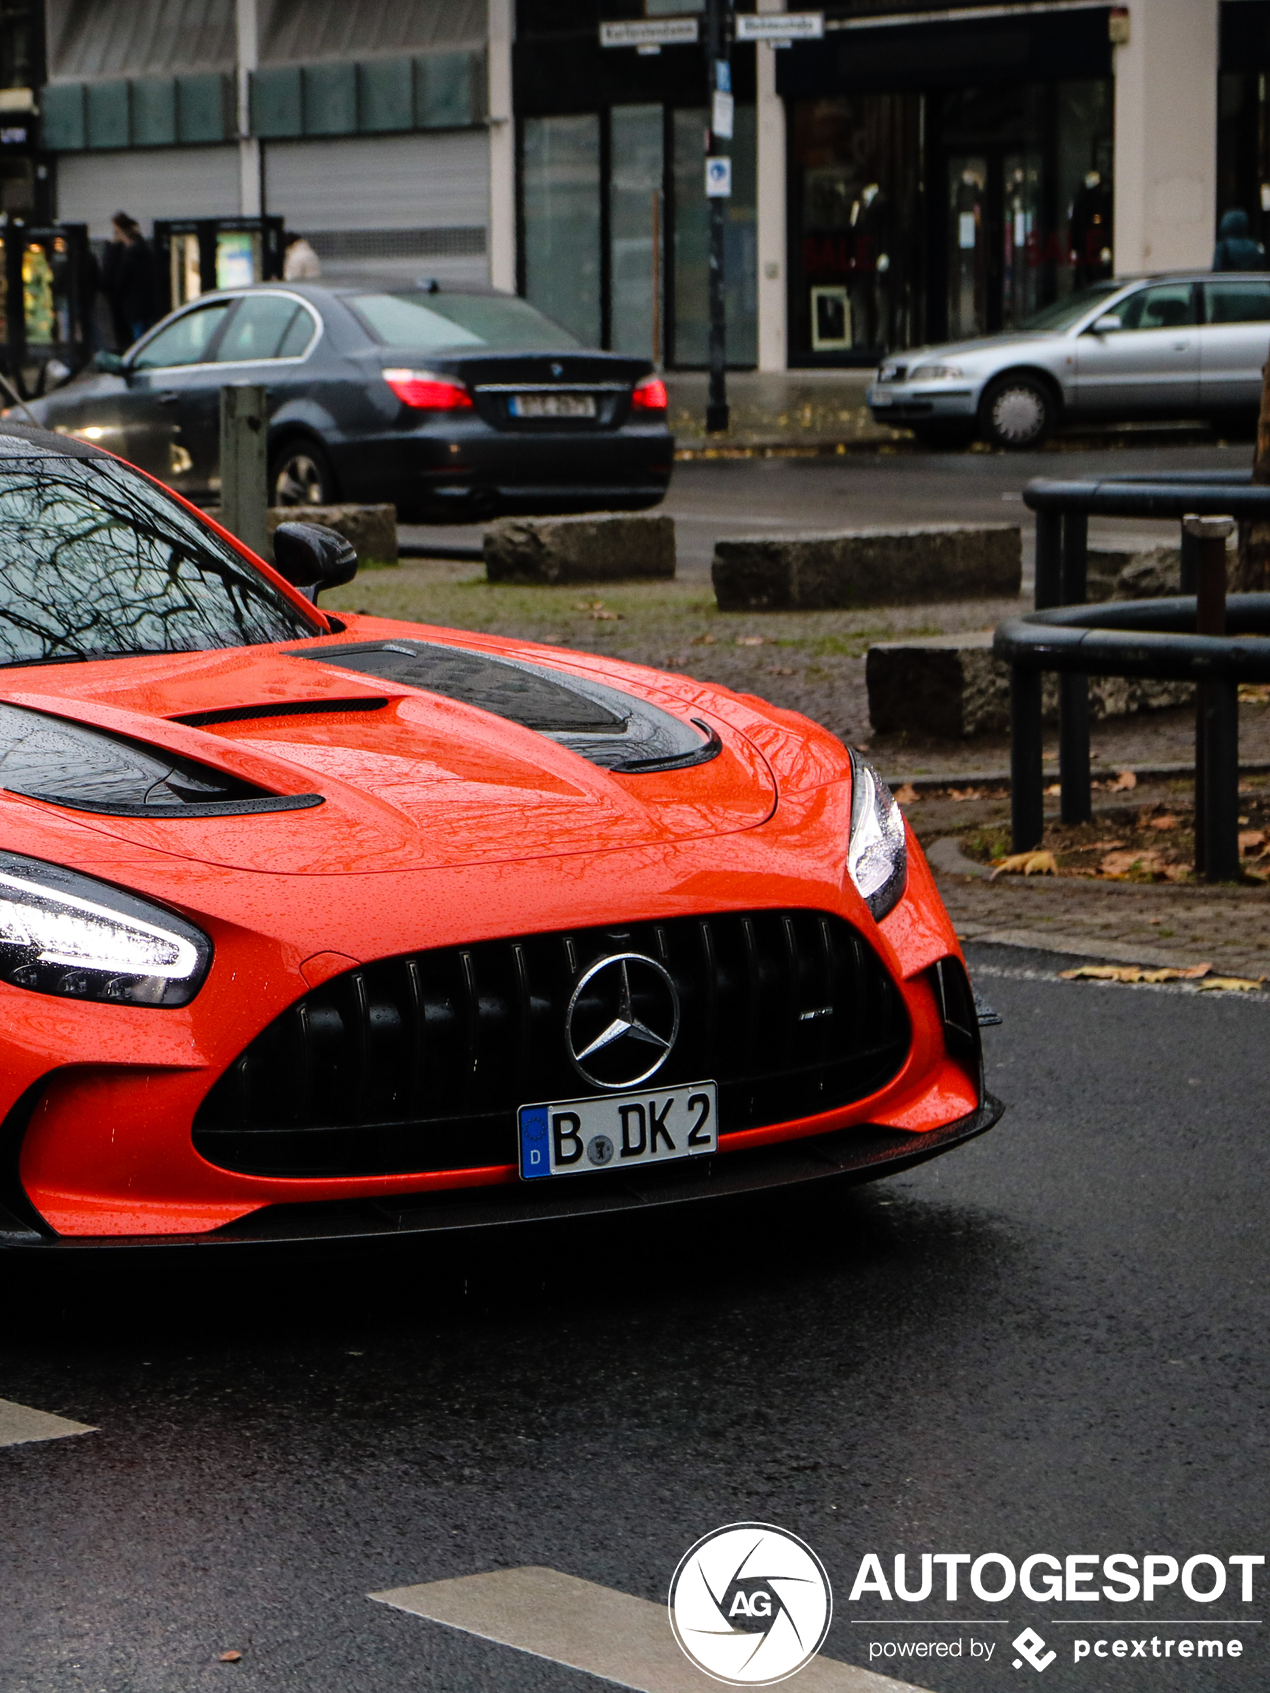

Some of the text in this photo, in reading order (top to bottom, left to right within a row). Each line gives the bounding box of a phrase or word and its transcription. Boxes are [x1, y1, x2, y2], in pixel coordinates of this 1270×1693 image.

[552, 1092, 711, 1166] B DK 2
[530, 1150, 541, 1165] D
